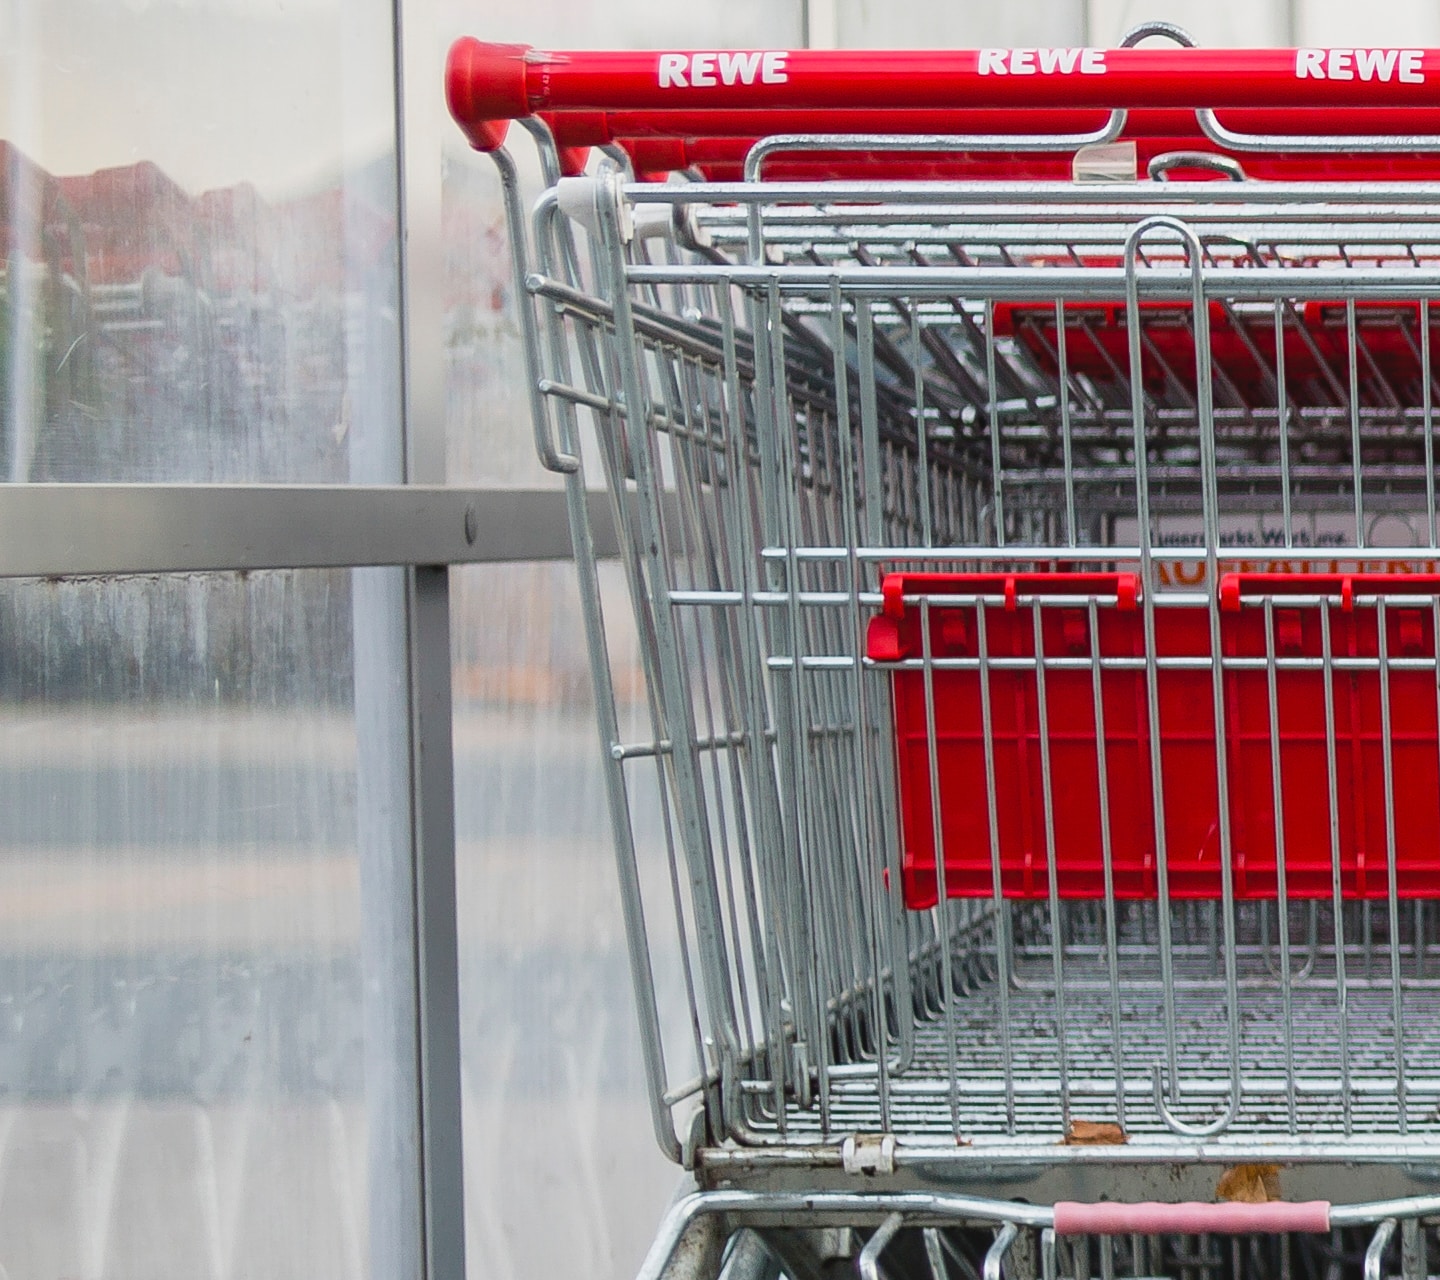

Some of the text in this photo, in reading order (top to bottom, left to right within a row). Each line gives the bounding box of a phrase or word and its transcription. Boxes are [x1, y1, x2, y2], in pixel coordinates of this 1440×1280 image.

[658, 48, 1425, 88] REWE REWE REWE
